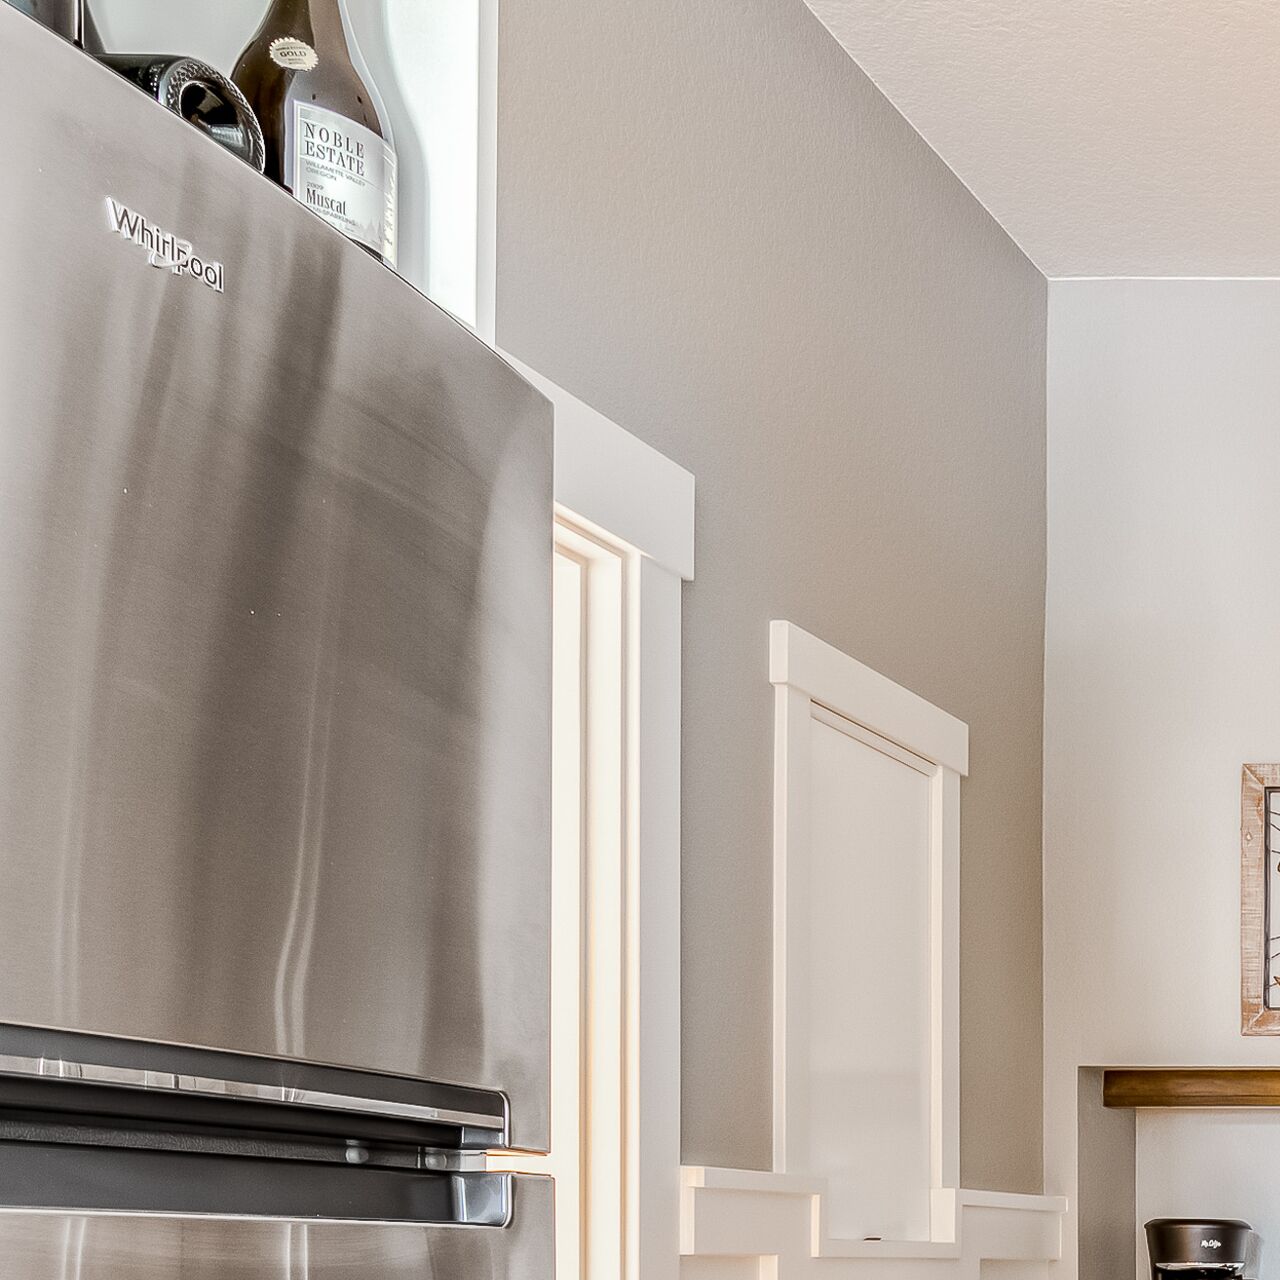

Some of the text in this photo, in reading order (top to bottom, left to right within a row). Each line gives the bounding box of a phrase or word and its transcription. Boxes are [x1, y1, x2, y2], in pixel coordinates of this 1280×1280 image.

[304, 121, 364, 159] NOBLE
[305, 140, 365, 177] ESTATE
[306, 187, 347, 216] Muscat
[105, 195, 224, 294] Whirlpool
